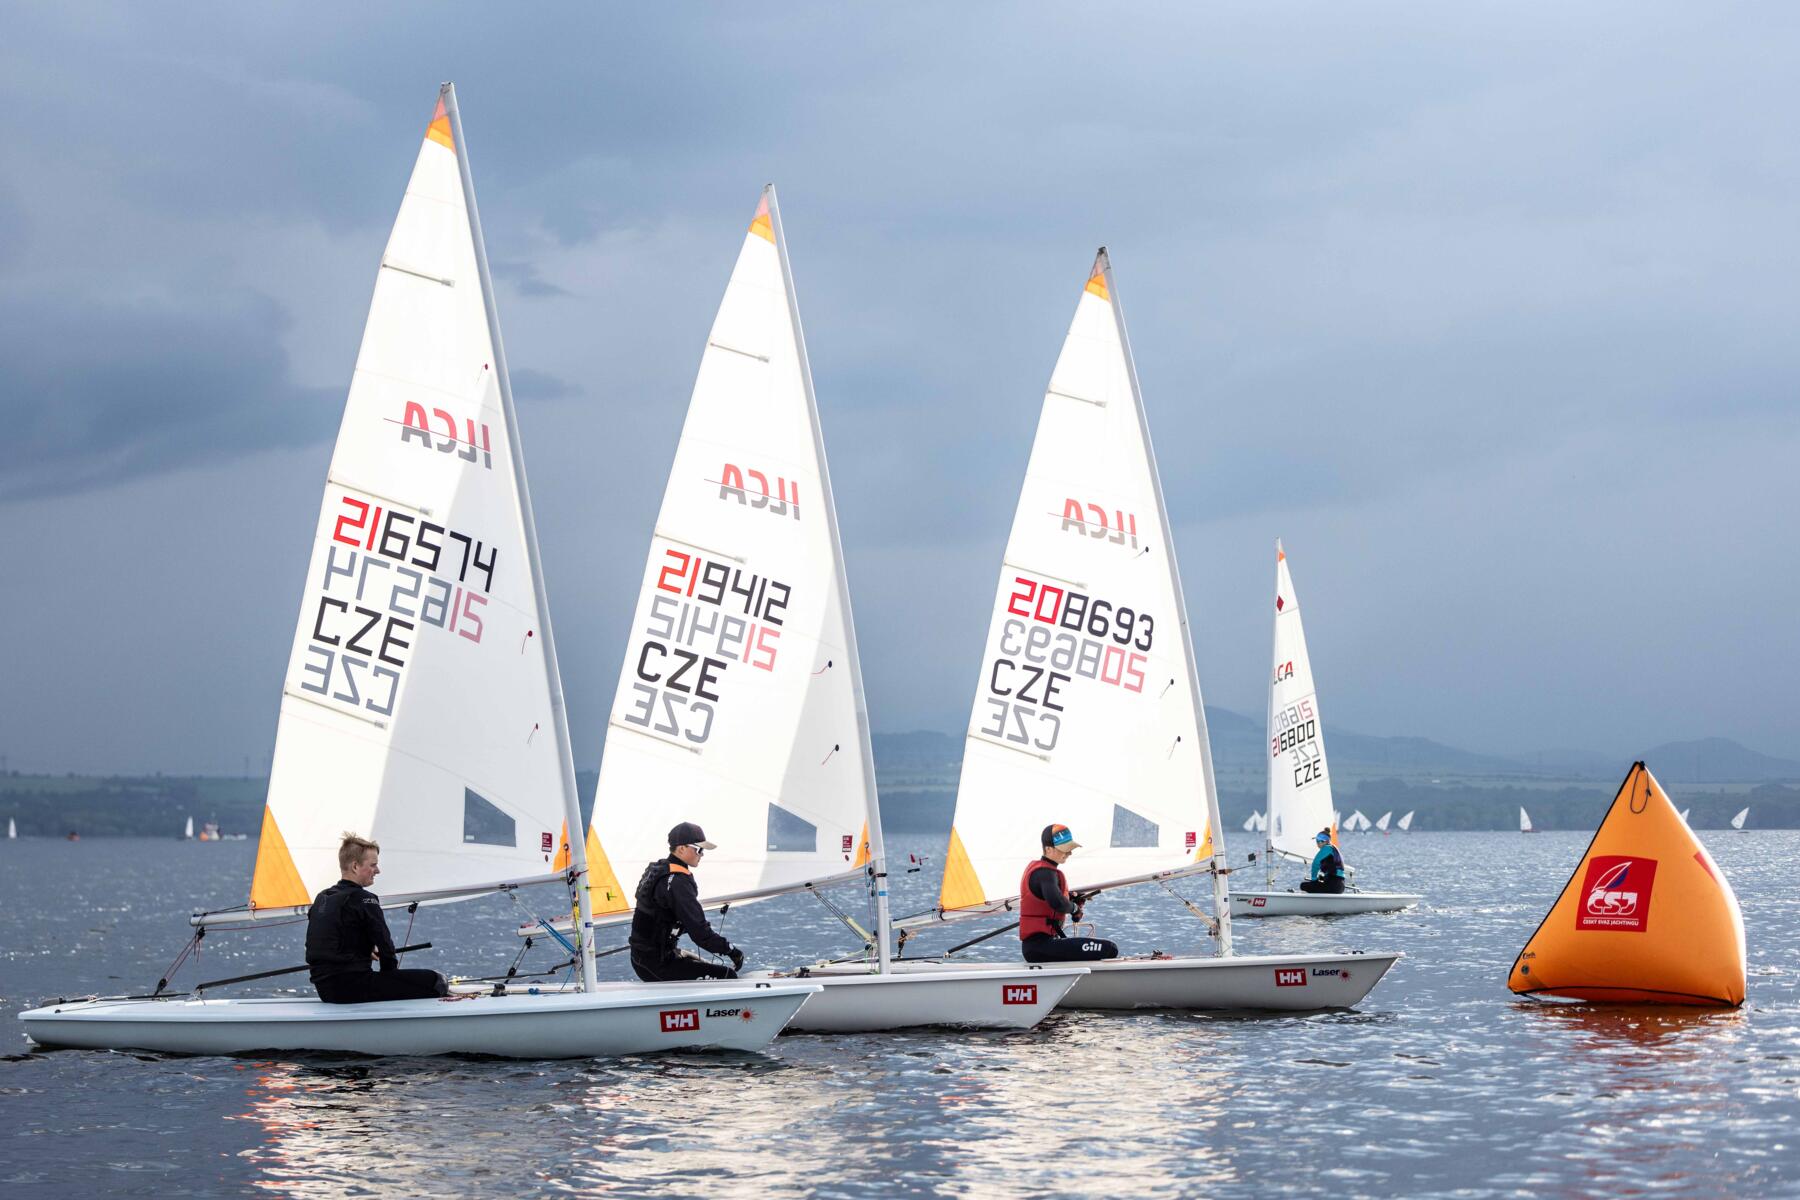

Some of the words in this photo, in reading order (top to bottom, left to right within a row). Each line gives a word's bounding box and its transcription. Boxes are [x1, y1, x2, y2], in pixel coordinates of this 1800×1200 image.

[333, 496, 497, 593] 216574
[657, 549, 791, 626] 219412
[312, 596, 414, 667] CZE
[1007, 577, 1154, 651] 208693
[637, 640, 727, 702] CZE
[990, 658, 1071, 712] CZE
[1273, 661, 1293, 685] LCA
[1272, 719, 1315, 758] 216800
[1295, 759, 1321, 788] CZE
[1082, 941, 1102, 951] Gill
[1312, 968, 1340, 976] Laser
[706, 1008, 741, 1018] Laser
